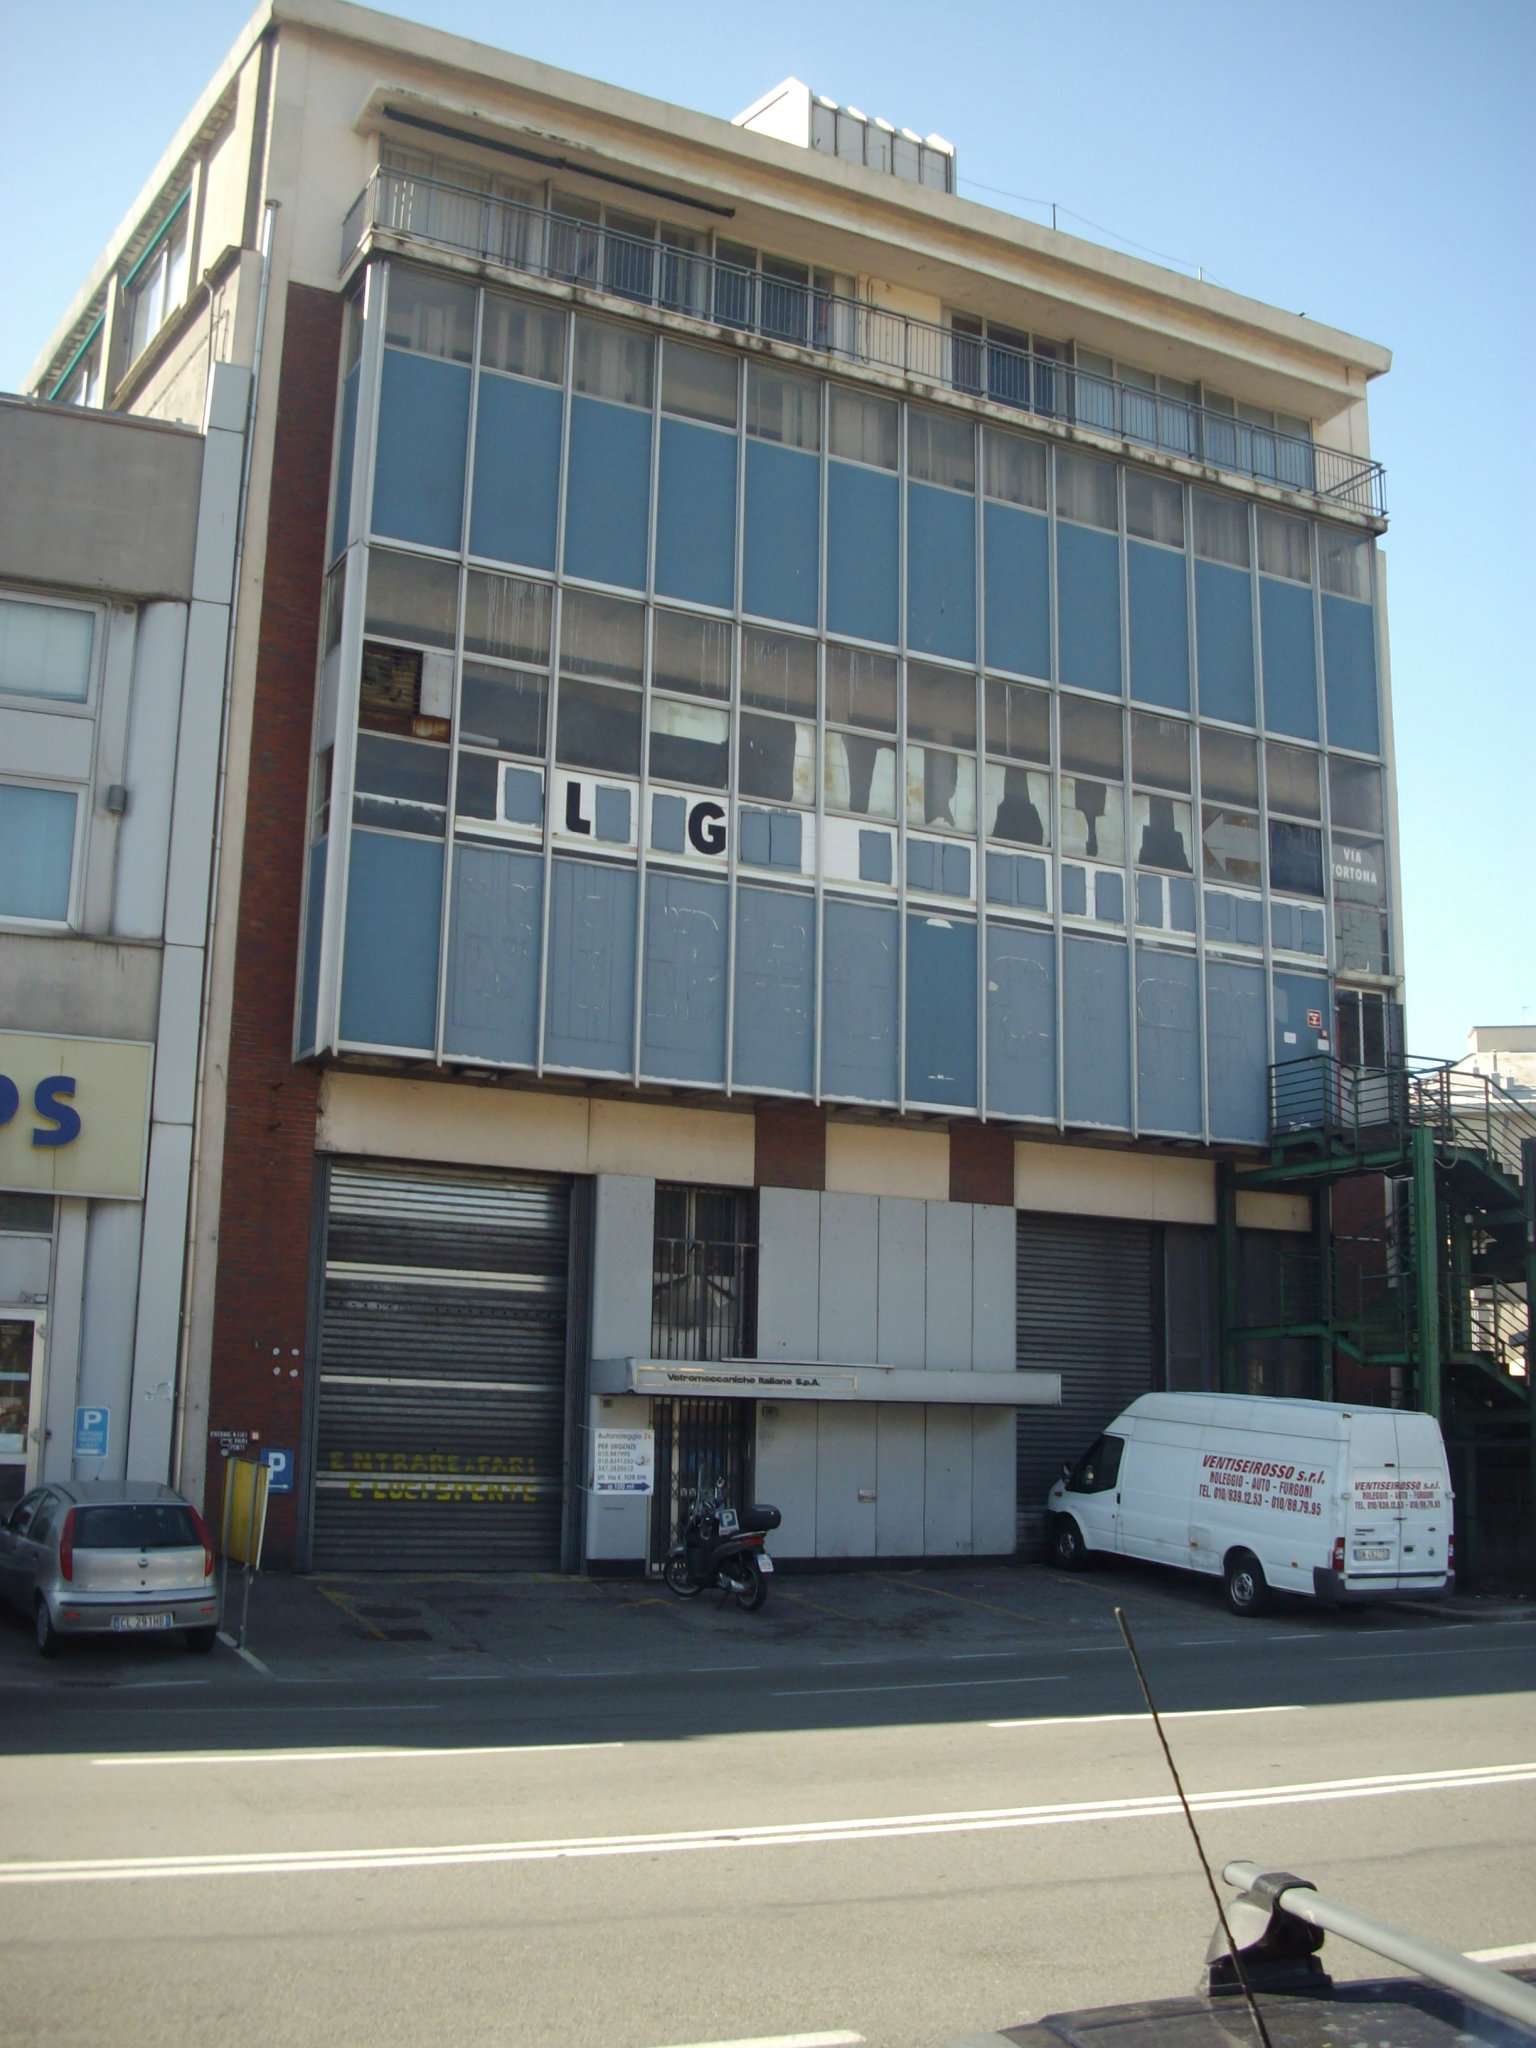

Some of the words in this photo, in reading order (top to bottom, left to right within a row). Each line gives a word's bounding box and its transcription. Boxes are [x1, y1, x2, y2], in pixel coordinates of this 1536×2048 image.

[688, 801, 727, 855] G
[1343, 848, 1362, 864] VIA
[667, 1373, 756, 1386] Vetromeccaniche
[758, 1376, 793, 1387] Italiane
[84, 1411, 102, 1430] P
[268, 1452, 286, 1481] P
[328, 1451, 460, 1472] ENTRARE
[476, 1455, 537, 1474] FARI
[1202, 1454, 1295, 1479] VENTISEIROSSO
[1209, 1471, 1243, 1488] NOLEGGIO
[1251, 1477, 1271, 1492] AUTO
[1279, 1481, 1313, 1498] FURGONI
